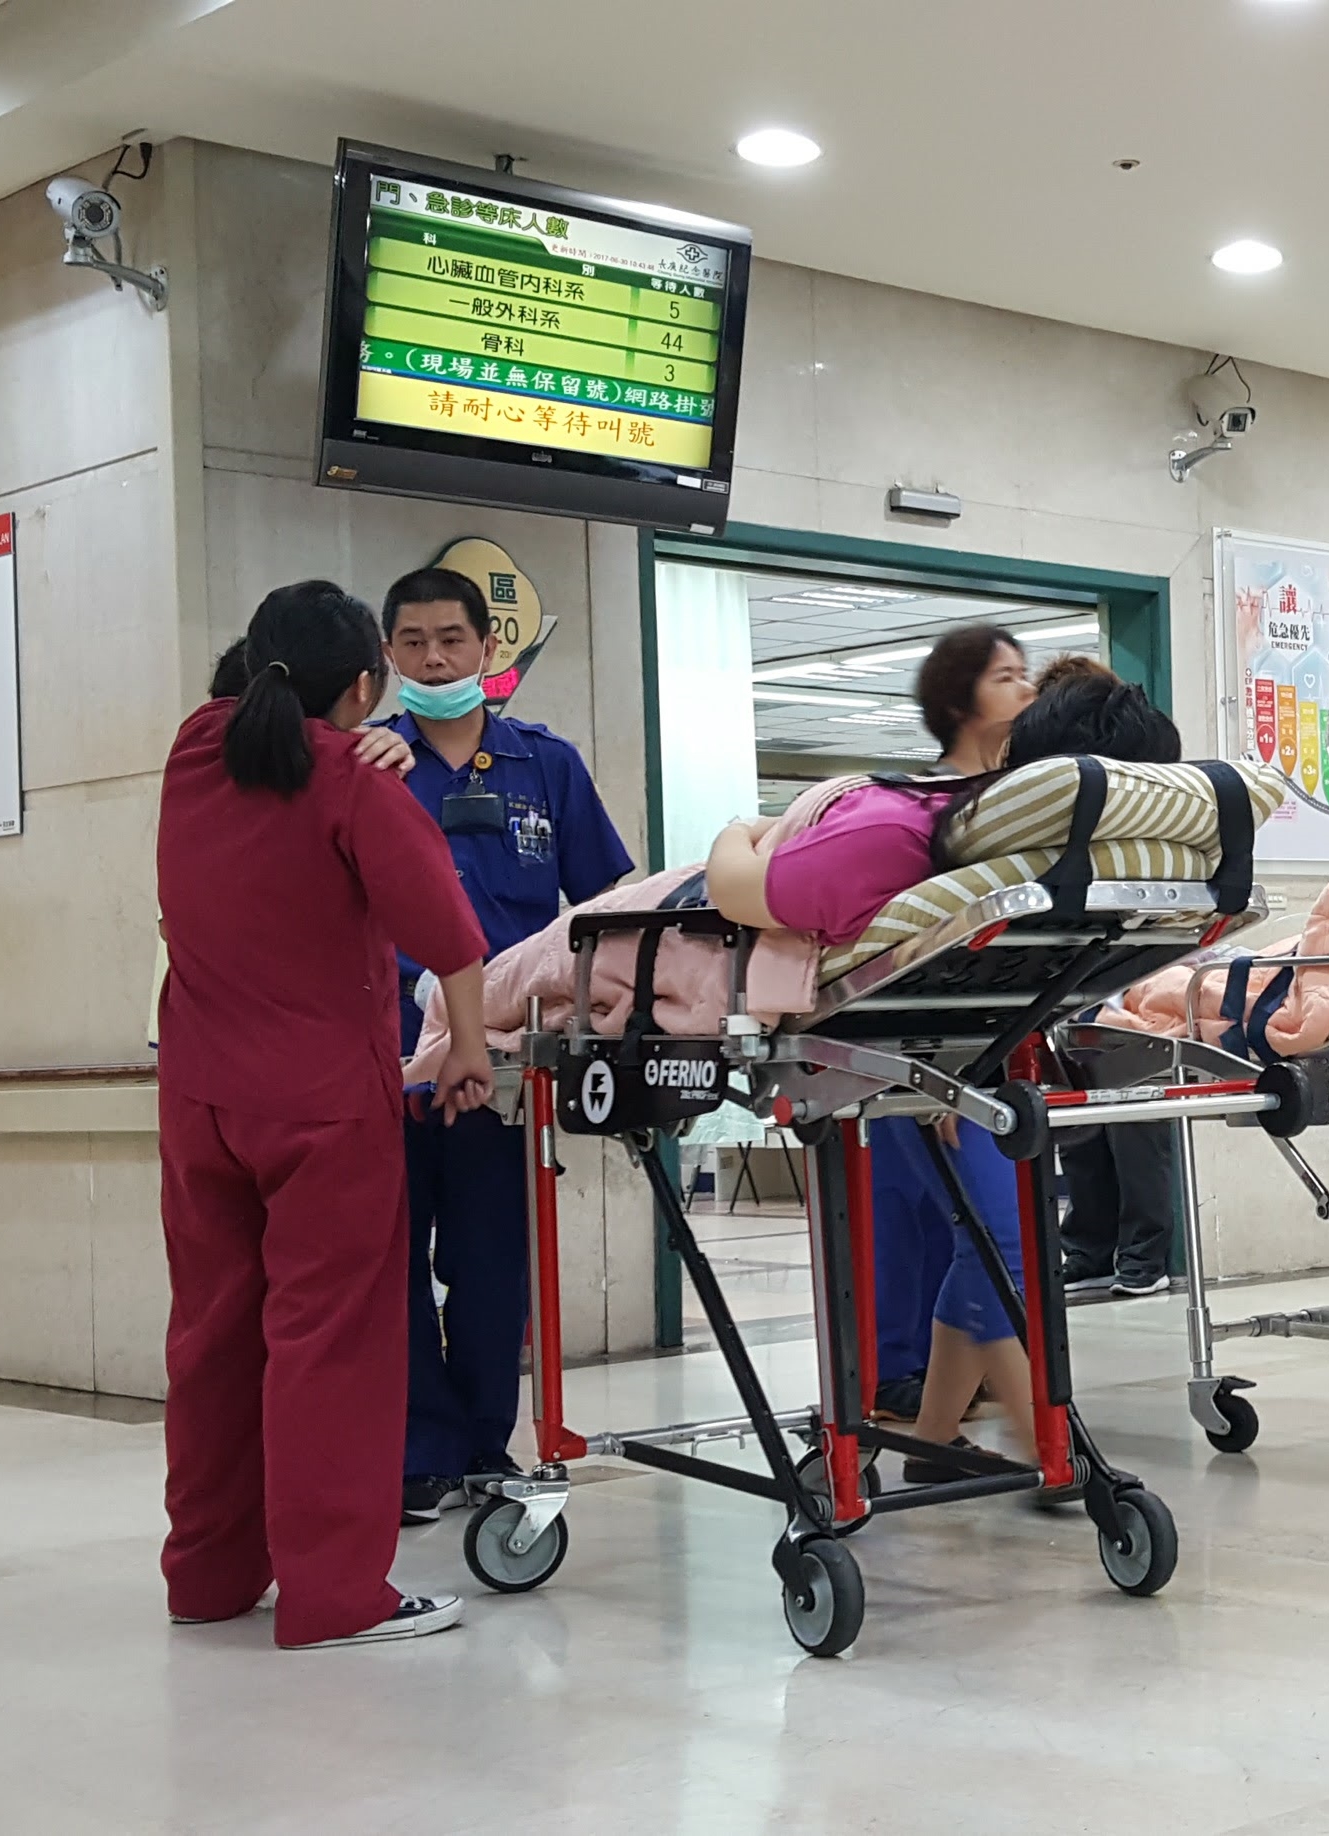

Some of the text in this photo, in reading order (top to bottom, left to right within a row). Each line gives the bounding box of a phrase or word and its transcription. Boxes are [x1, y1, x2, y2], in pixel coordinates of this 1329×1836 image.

[650, 276, 706, 299] 等待人數
[447, 296, 561, 331] 一般外科系
[669, 300, 681, 319] 5
[480, 332, 525, 357] 骨科
[660, 331, 684, 353] 44
[663, 363, 676, 383] 3
[427, 389, 656, 448] 請耐心等待叫號
[488, 571, 519, 605] 區
[1268, 621, 1311, 642] 危急優先
[1270, 640, 1309, 652] EMERGENCY
[658, 1059, 717, 1088] FERNO
